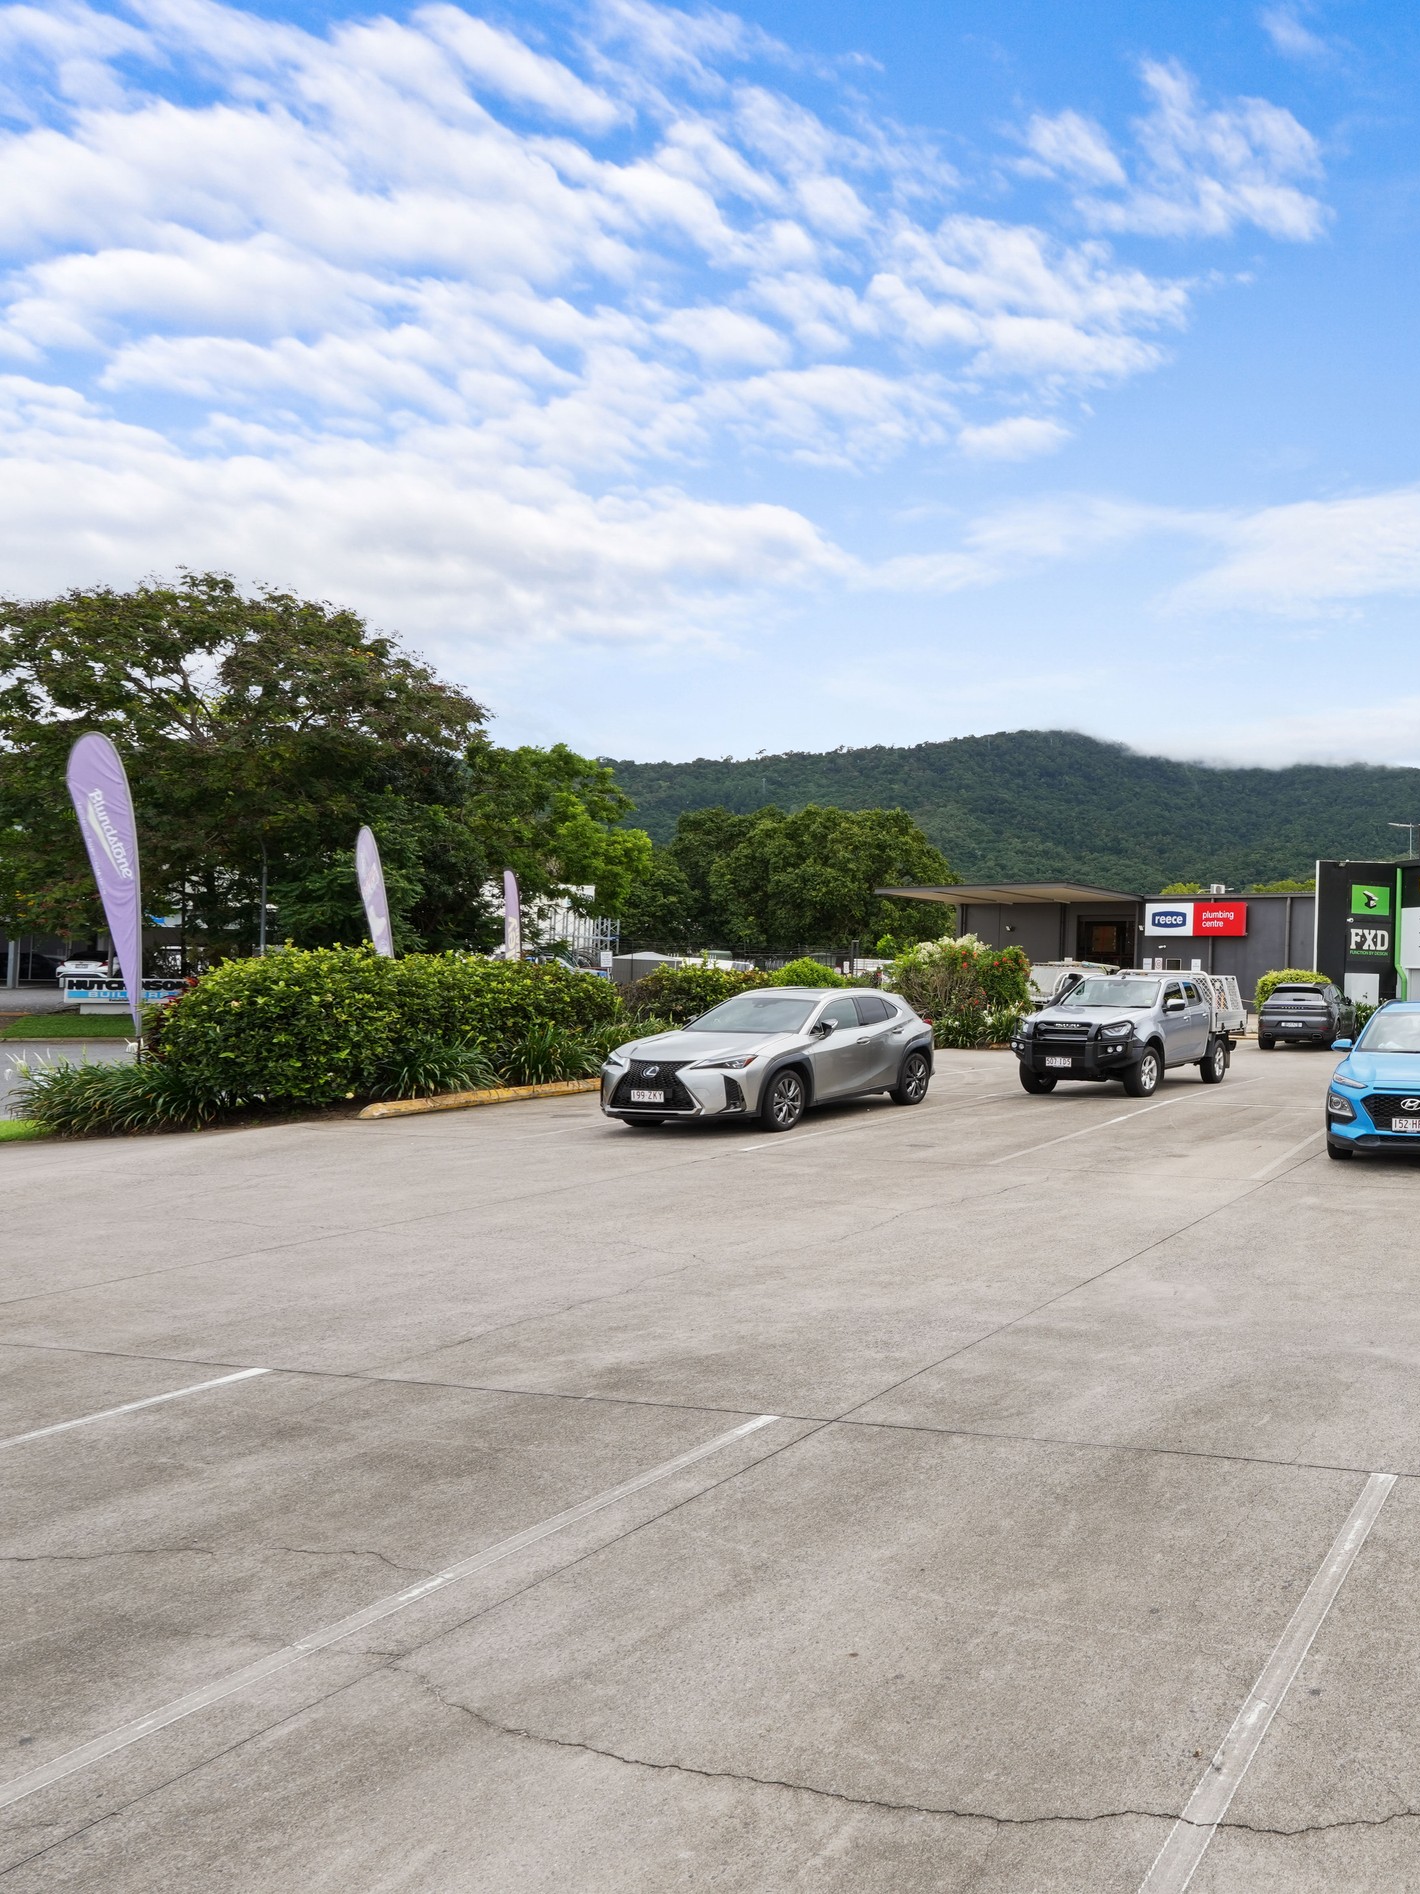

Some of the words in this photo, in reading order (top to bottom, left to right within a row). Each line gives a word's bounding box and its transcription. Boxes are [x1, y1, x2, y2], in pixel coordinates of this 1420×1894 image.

[87, 788, 134, 880] Blundstone
[1154, 915, 1183, 925] reece
[1202, 910, 1234, 920] plumbing
[1202, 919, 1224, 928] centre
[647, 1091, 663, 1100] ZKY
[1394, 1119, 1408, 1129] 152
